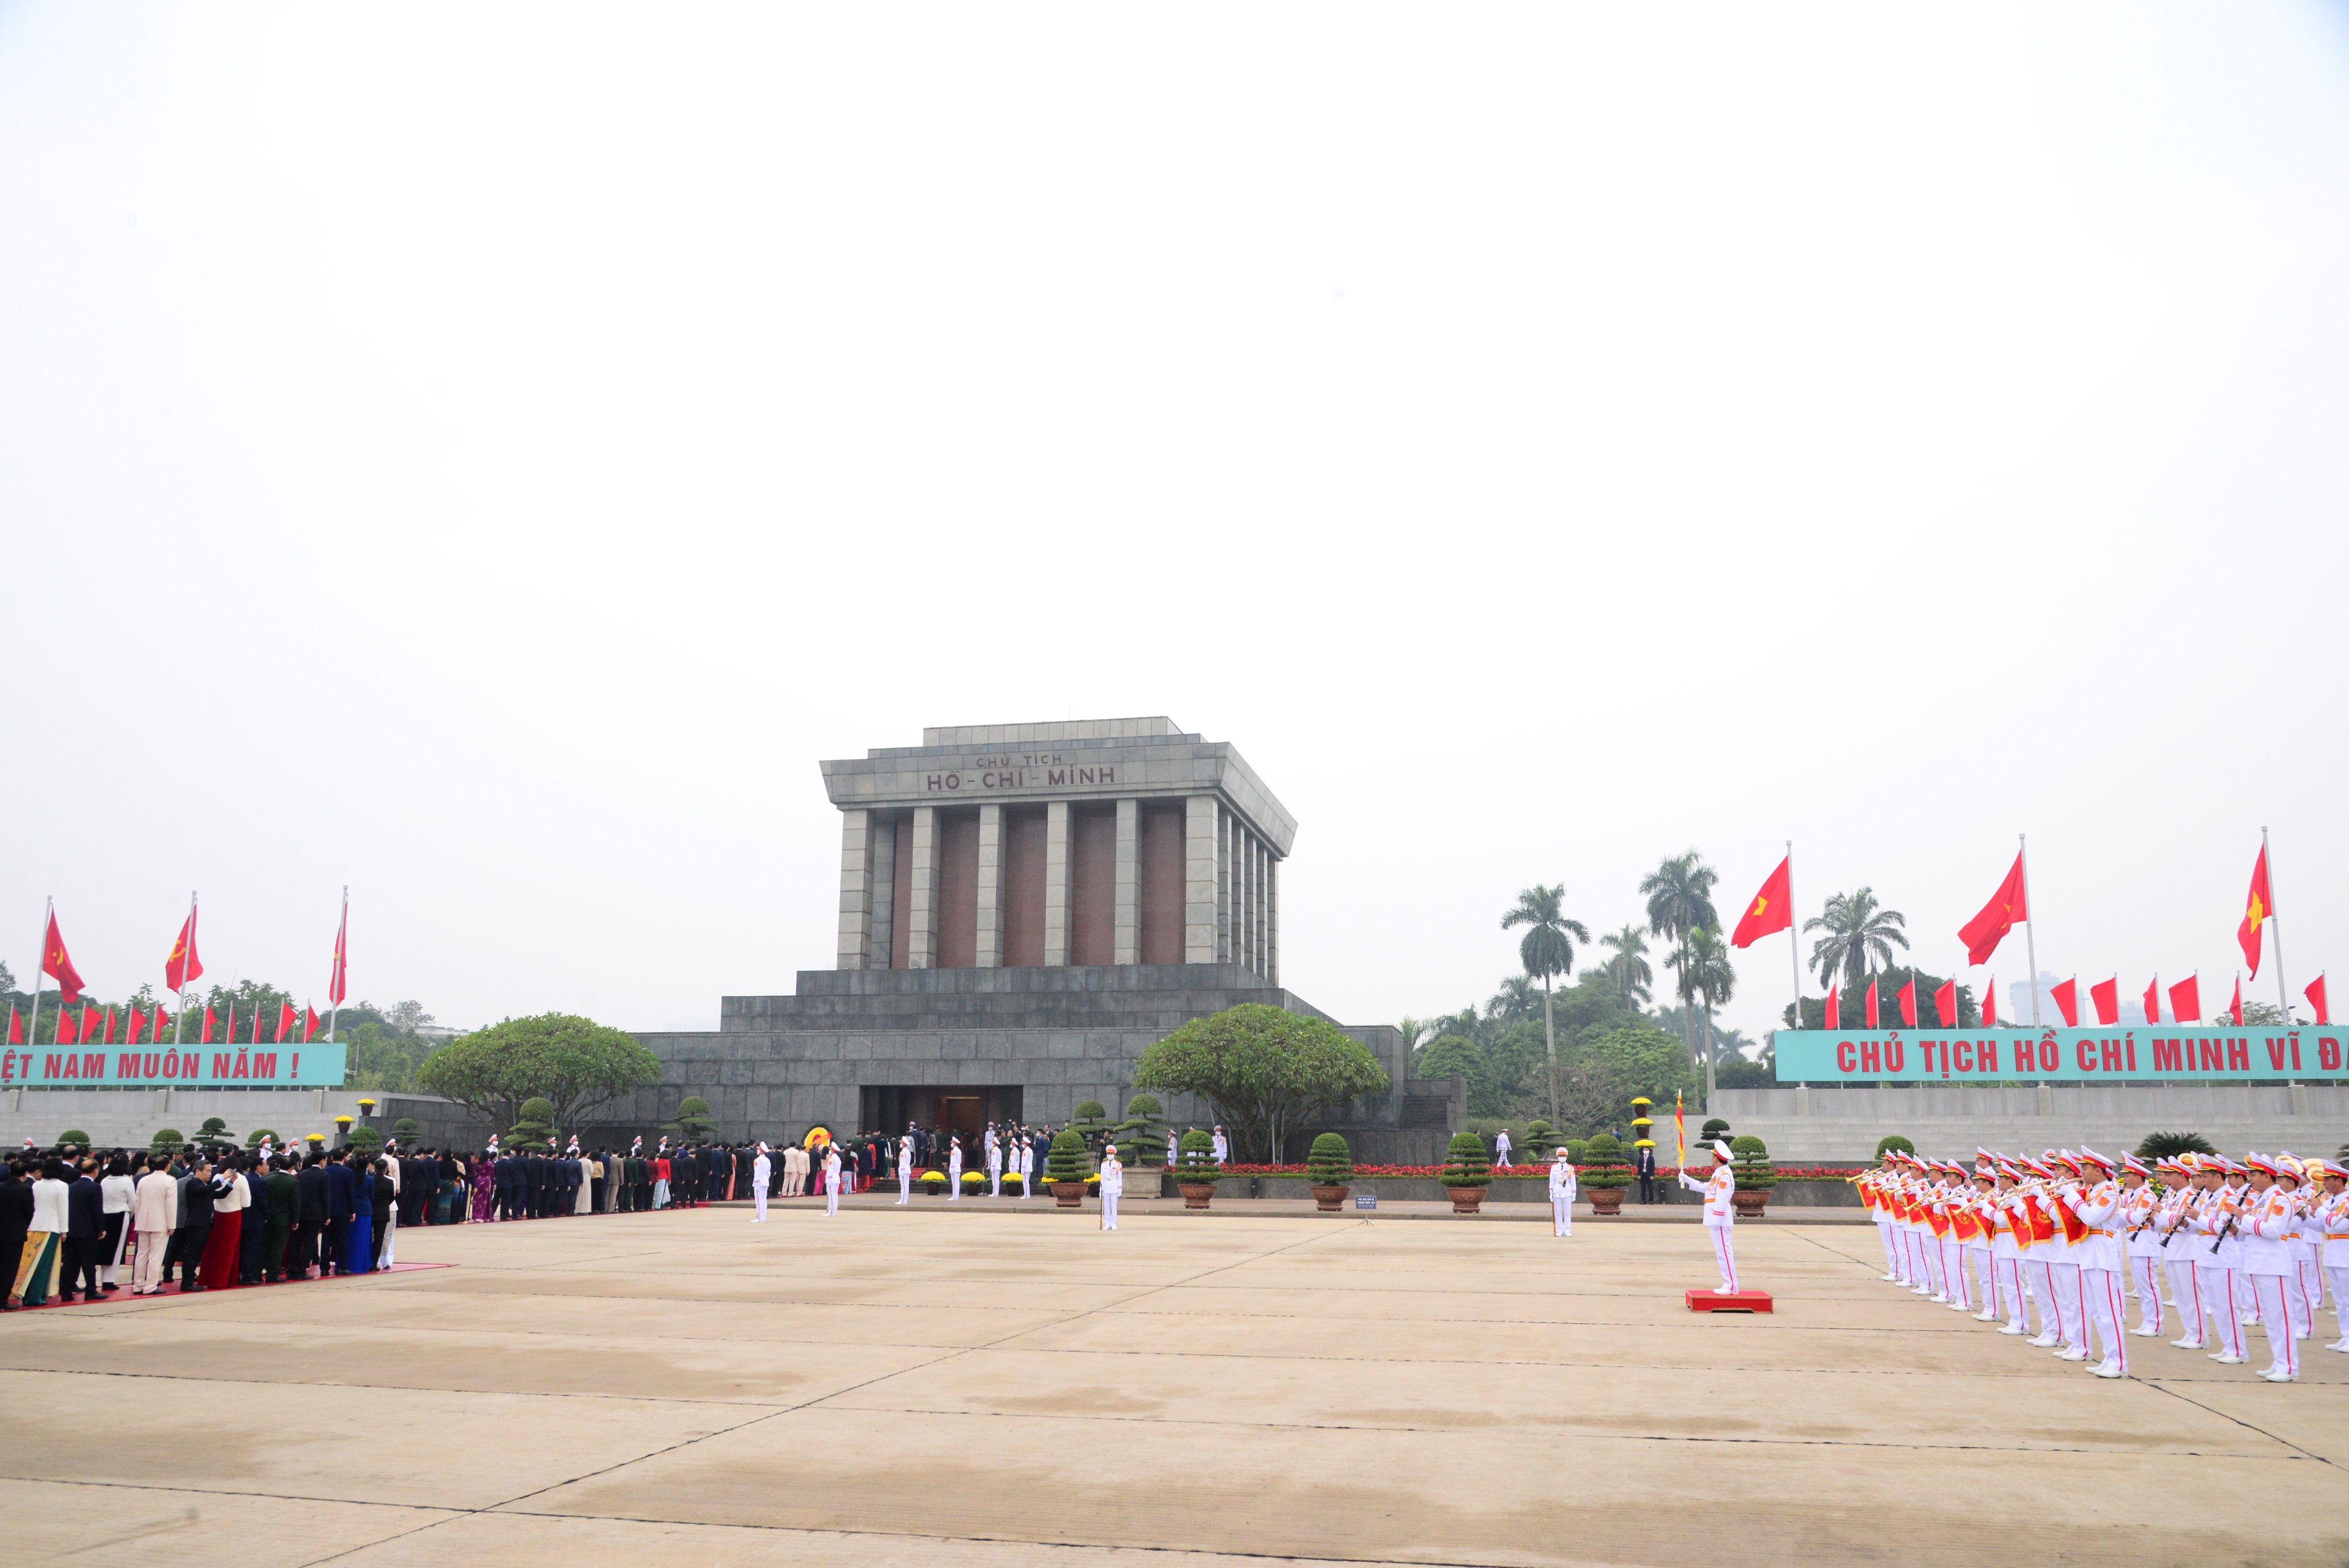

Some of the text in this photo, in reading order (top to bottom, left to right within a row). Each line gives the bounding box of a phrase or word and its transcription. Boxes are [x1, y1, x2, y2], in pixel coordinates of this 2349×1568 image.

[927, 770, 960, 790] HỒ
[982, 767, 1024, 789] CHÍ
[44, 1054, 106, 1078] NAM
[118, 1048, 200, 1078] MUÔN
[212, 1047, 276, 1078] NĂM
[1837, 1029, 2349, 1078] CHỦ TỊCH HỒ CHÍ MINH VĨ Đ
